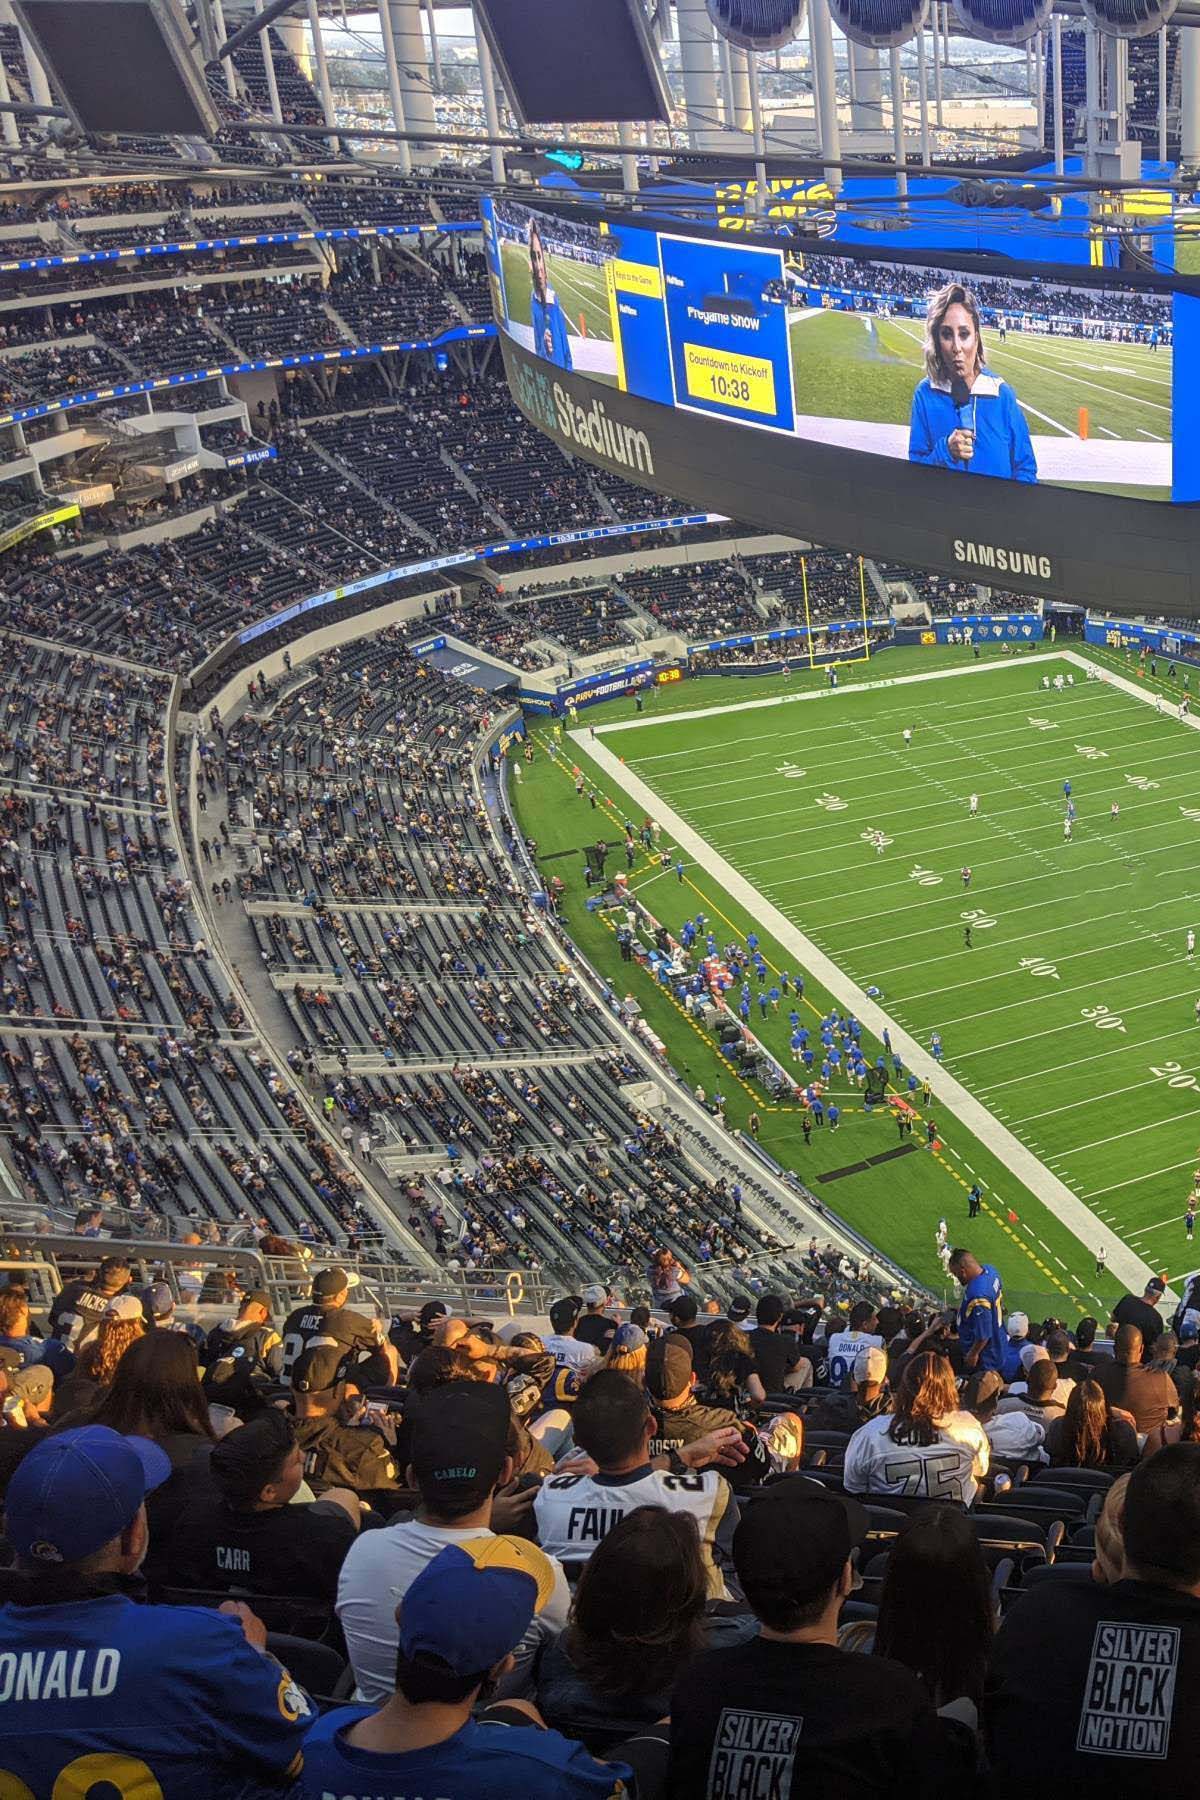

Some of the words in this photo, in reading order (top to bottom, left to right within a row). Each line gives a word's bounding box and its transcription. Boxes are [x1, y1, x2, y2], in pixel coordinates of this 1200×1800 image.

[687, 306, 729, 325] Pregame
[731, 312, 760, 331] Show
[689, 352, 729, 371] Countdown
[730, 363, 738, 374] to
[740, 364, 768, 379] Kickoff
[710, 374, 750, 401] 10:38
[553, 382, 654, 475] Stadium
[954, 540, 1051, 578] SAMSUNG
[659, 669, 680, 682] 10:38
[300, 1314, 323, 1330] RICE
[838, 1343, 865, 1354] DONALD
[216, 1546, 250, 1571] CARR
[1099, 1628, 1172, 1662] SILVER
[1089, 1662, 1172, 1717] BLACK
[721, 1714, 794, 1752] SILVER
[1084, 1717, 1163, 1752] NATION
[711, 1751, 790, 1800] BLACK
